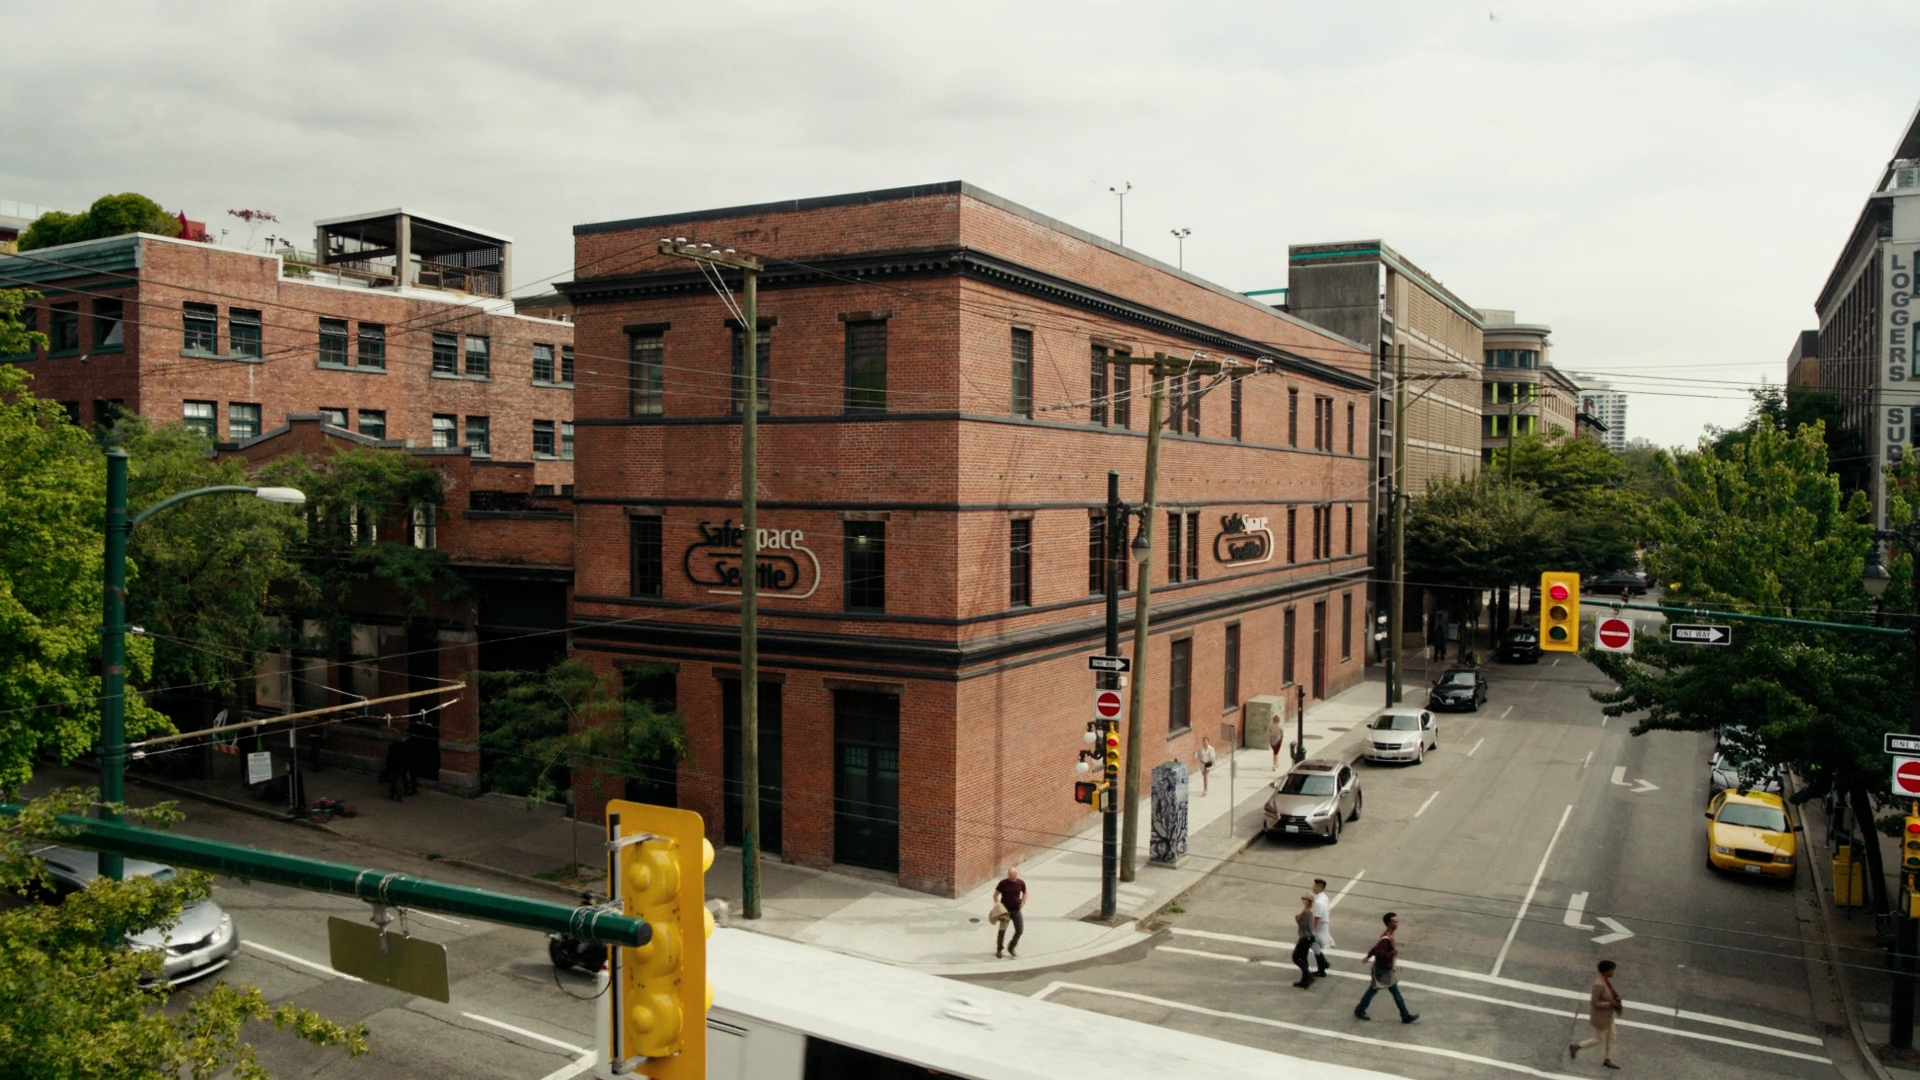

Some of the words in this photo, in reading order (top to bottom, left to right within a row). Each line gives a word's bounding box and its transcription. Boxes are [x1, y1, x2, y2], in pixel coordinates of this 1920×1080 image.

[1888, 254, 1911, 382] LOGGERS
[755, 528, 804, 551] pace
[1677, 630, 1692, 638] ONE
[1695, 630, 1711, 638] WAY
[1893, 740, 1909, 748] ONE
